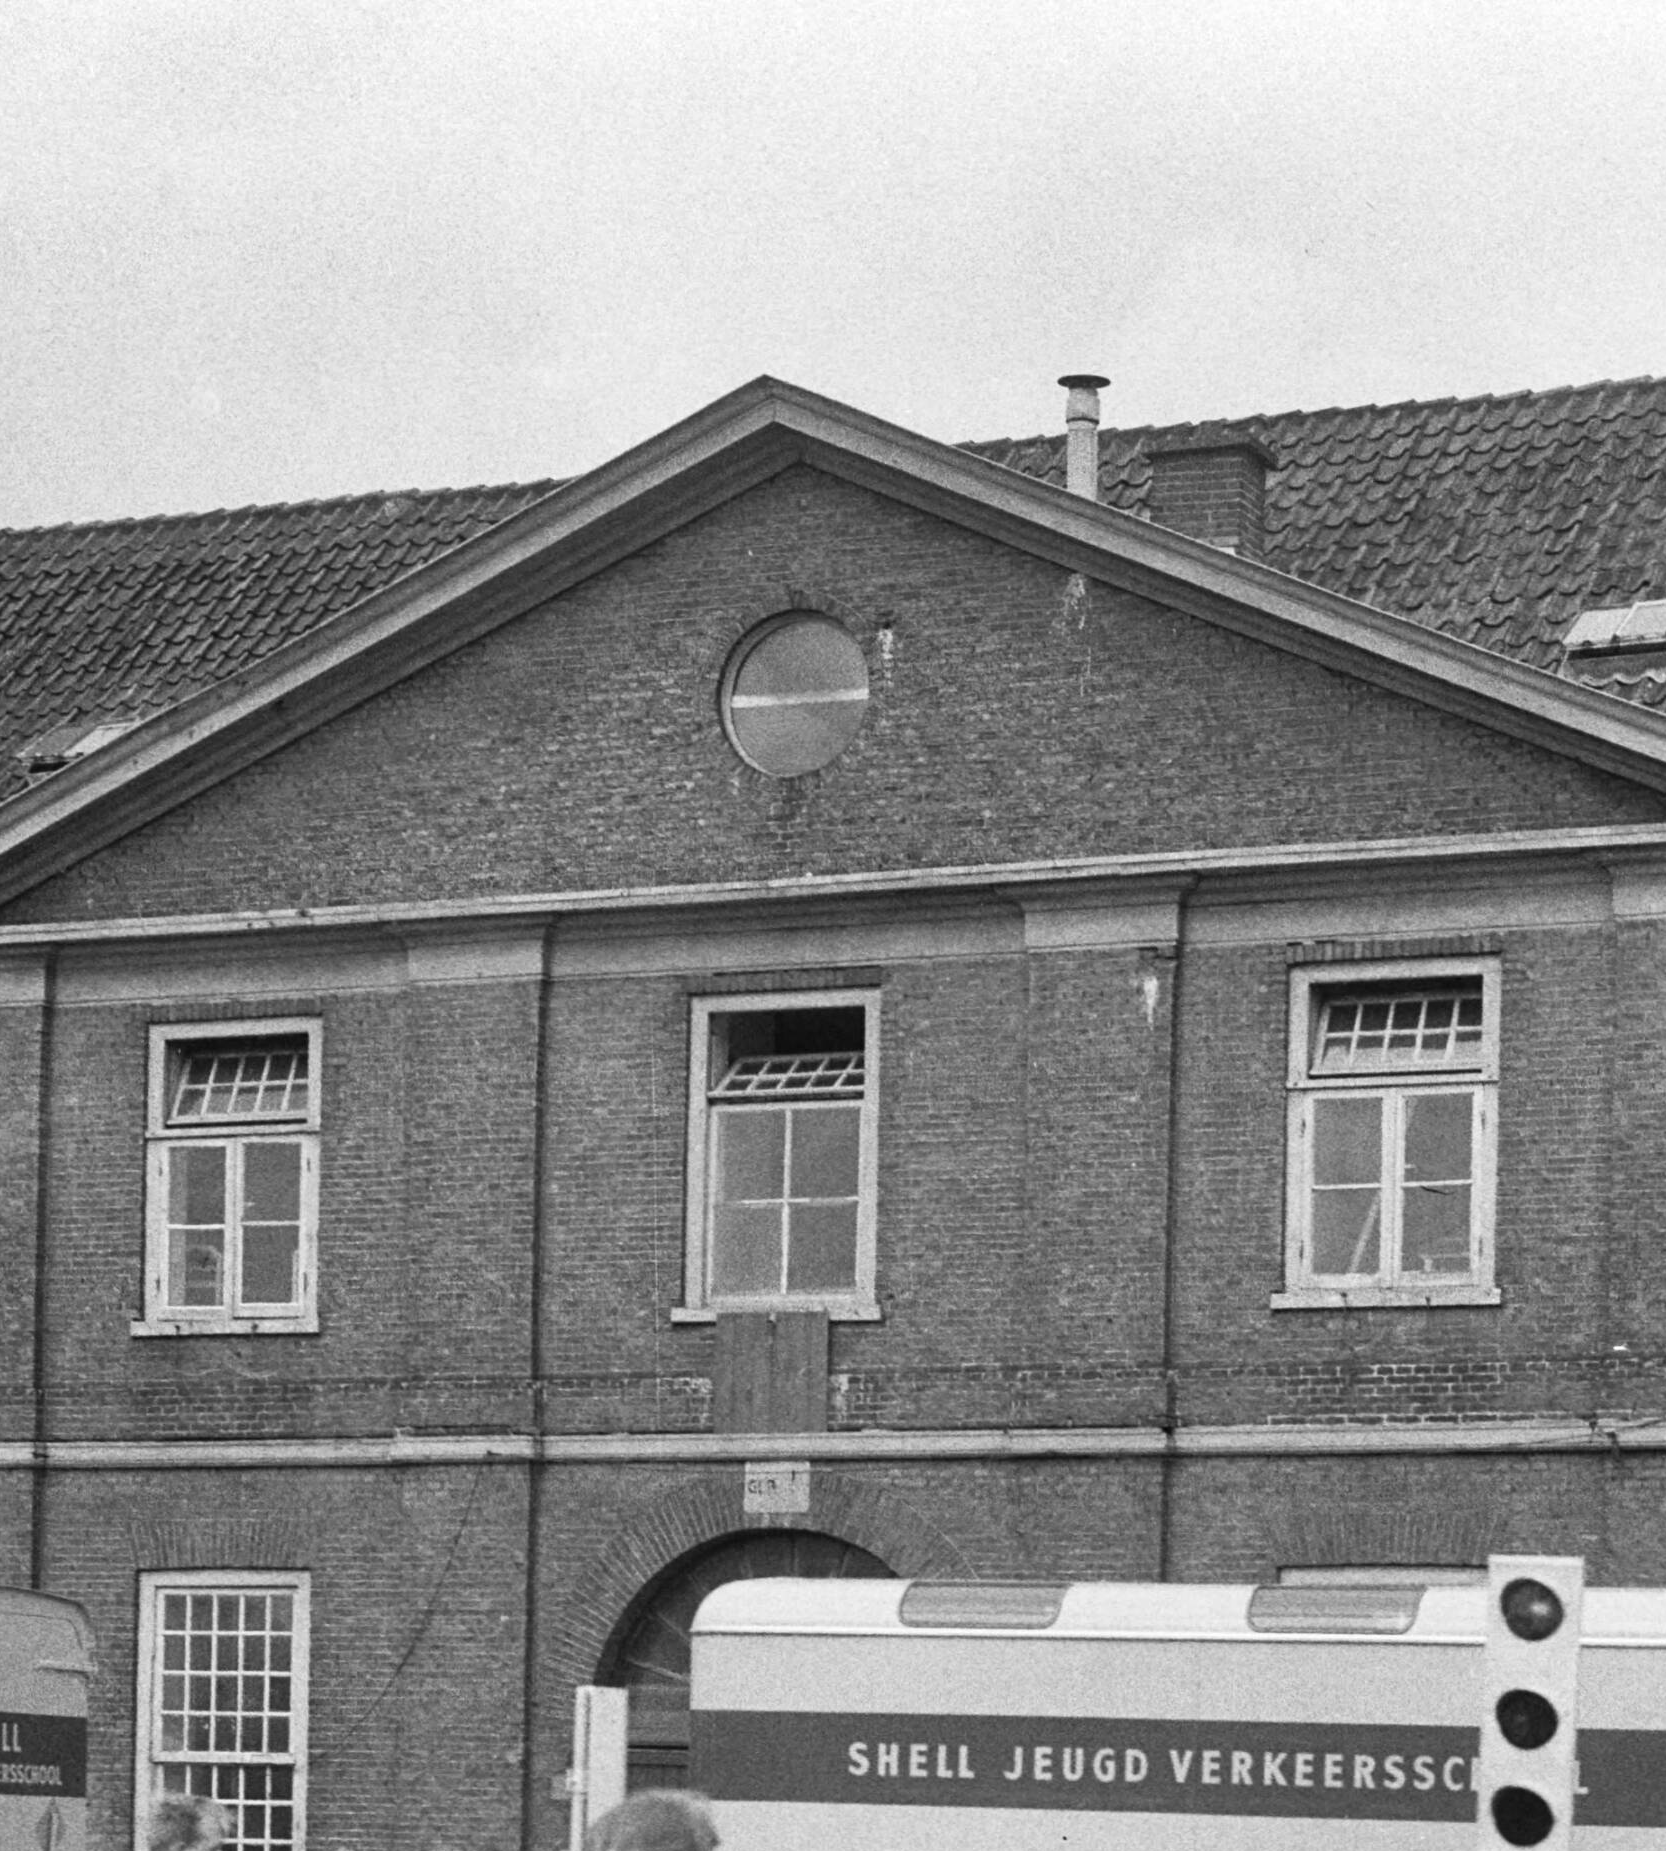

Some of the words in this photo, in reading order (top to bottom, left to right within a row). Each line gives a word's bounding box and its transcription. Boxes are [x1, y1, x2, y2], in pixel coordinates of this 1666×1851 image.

[847, 1740, 976, 1780] SHELL
[1002, 1745, 1151, 1785] JEUGD
[1168, 1748, 1590, 1795] VERKEERSSCL
